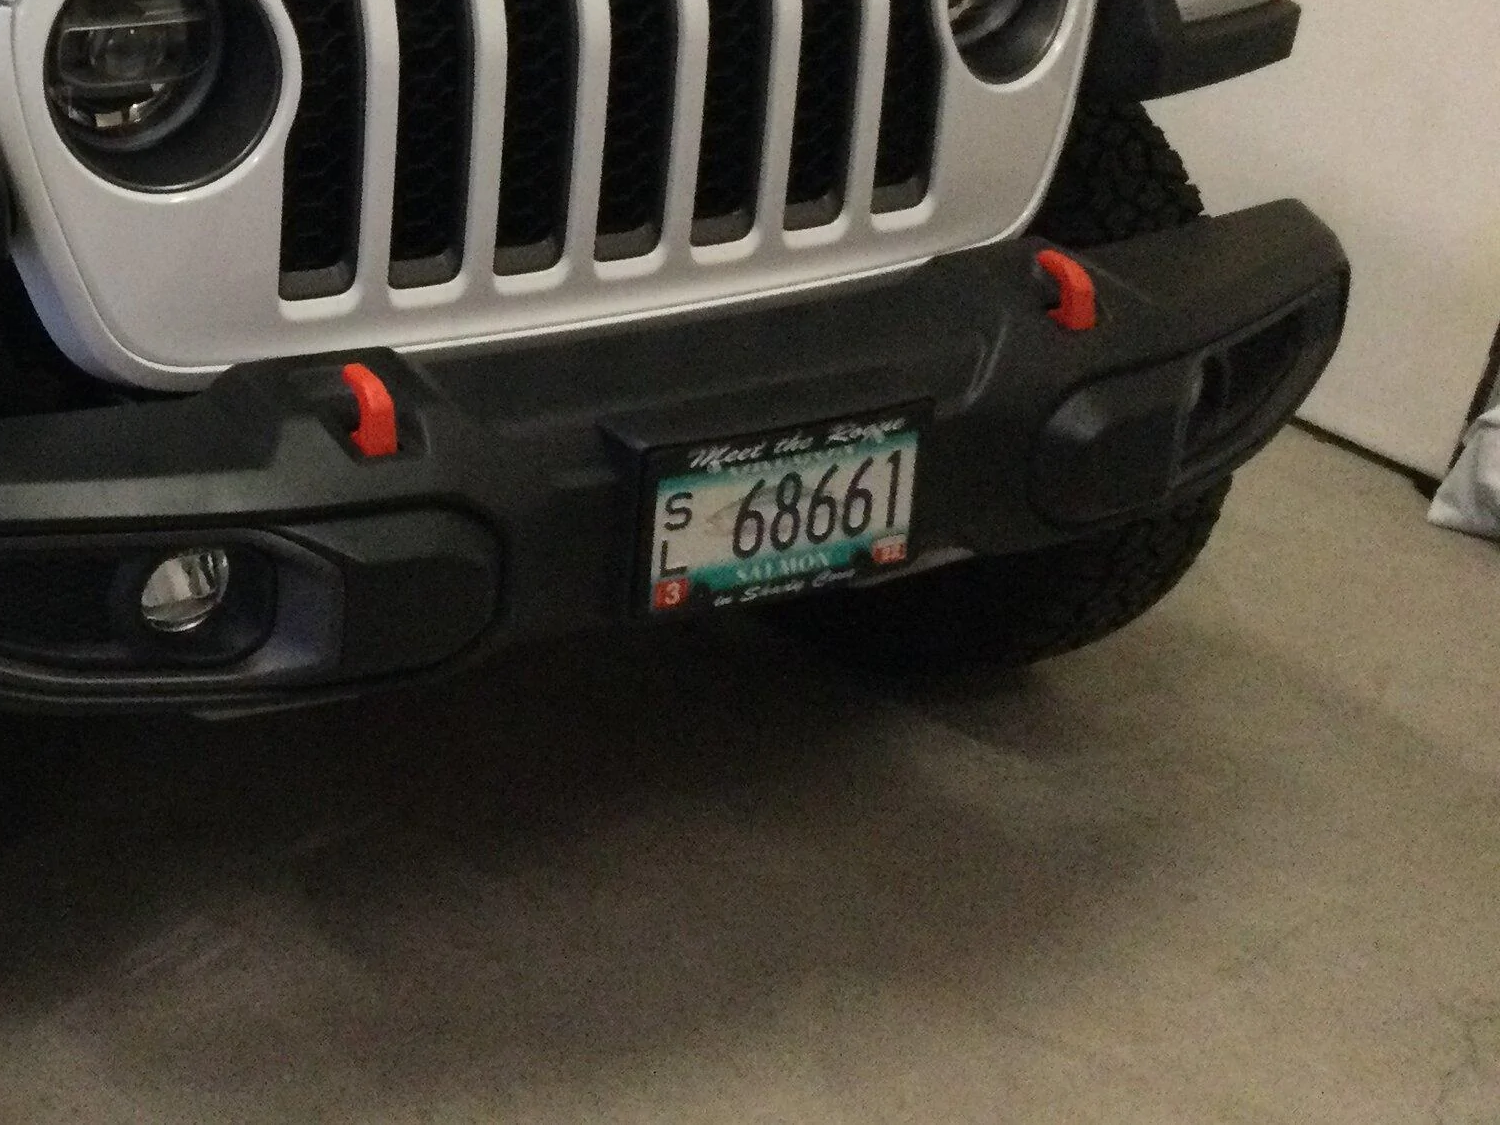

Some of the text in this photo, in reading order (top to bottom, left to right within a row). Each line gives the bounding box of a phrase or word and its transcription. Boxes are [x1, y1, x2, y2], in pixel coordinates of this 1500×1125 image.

[689, 440, 766, 468] Meet
[772, 430, 814, 454] the
[664, 492, 693, 531] S
[732, 450, 902, 559] 68661
[660, 540, 687, 577] L
[736, 552, 832, 582] SALMON
[663, 582, 681, 606] 3
